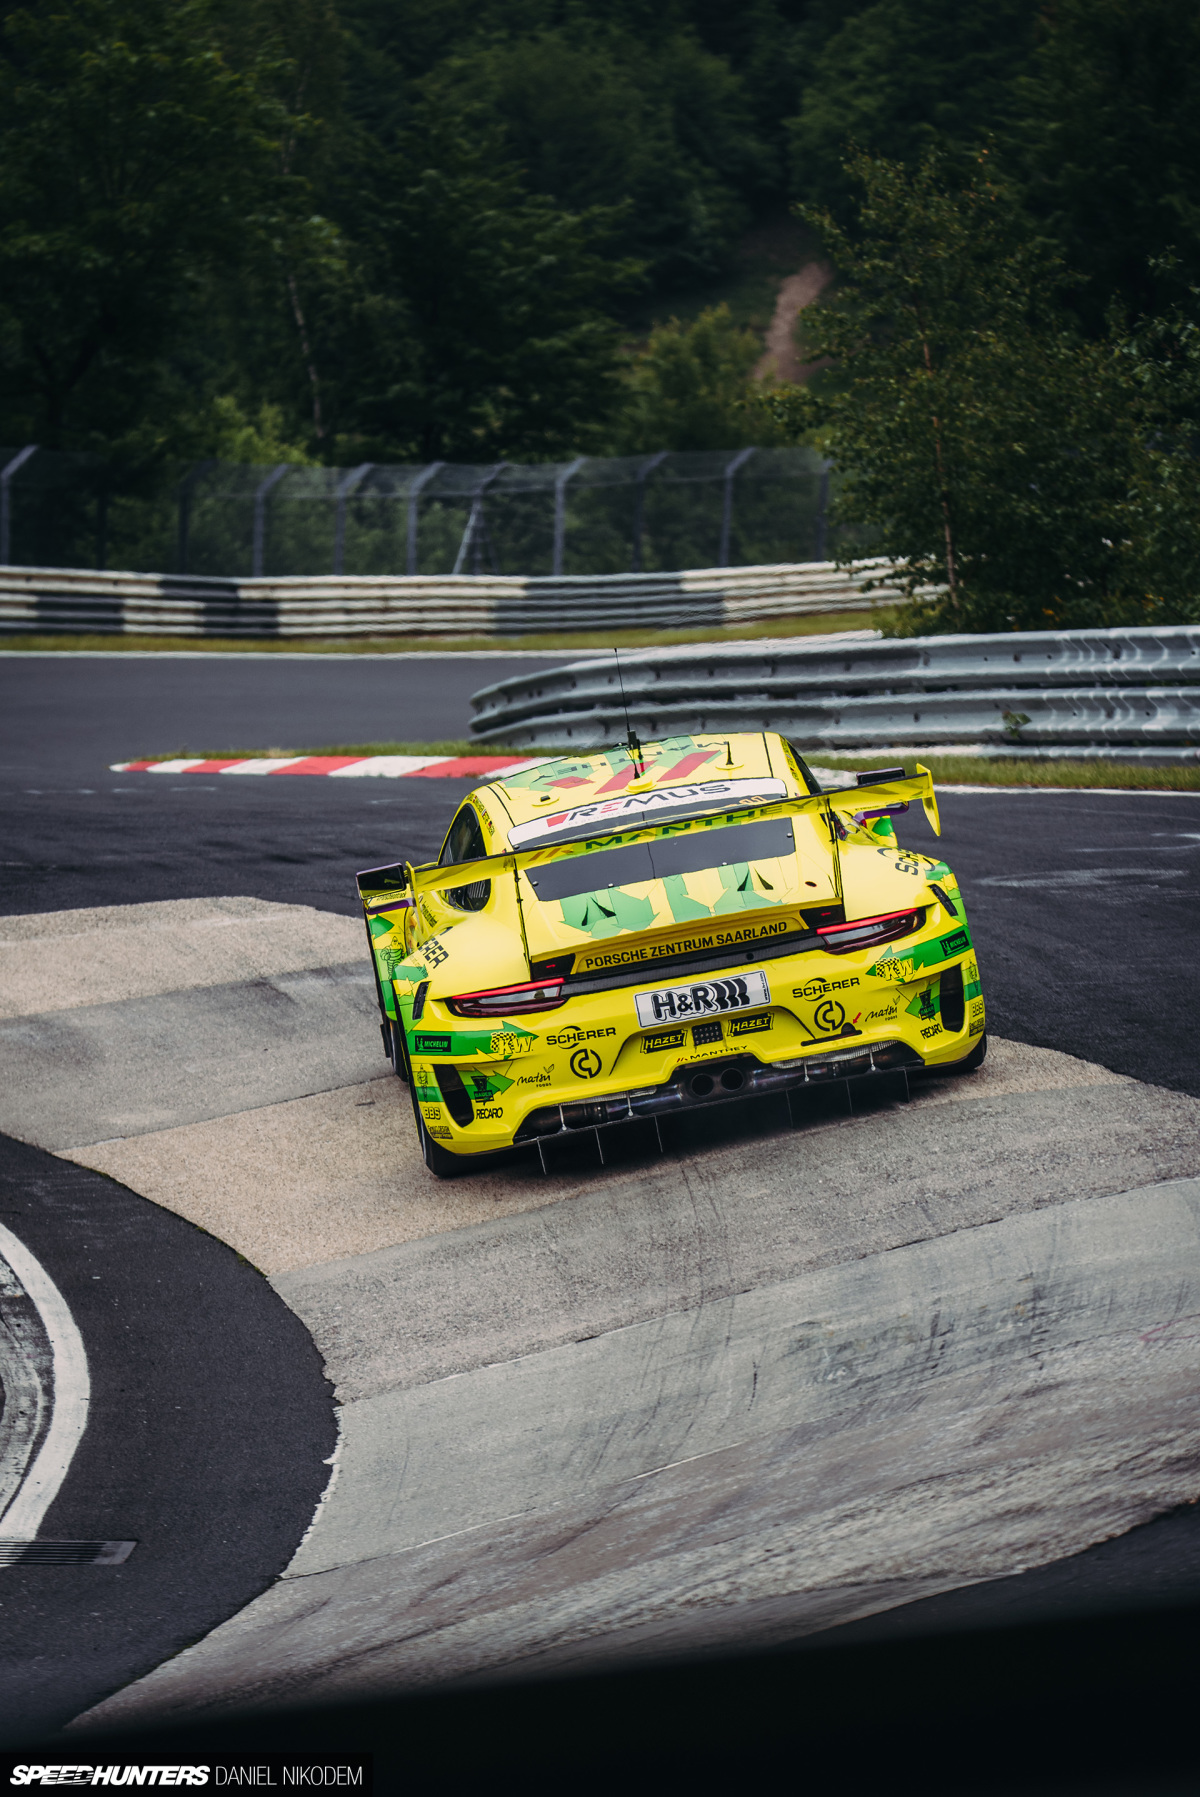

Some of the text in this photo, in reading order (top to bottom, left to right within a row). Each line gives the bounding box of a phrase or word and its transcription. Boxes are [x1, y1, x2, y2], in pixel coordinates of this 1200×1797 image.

[568, 784, 731, 821] REMUS
[585, 799, 817, 849] MANTHEY
[586, 921, 788, 968] PORSCHE ZENTRUM SAARLAND
[792, 977, 860, 998] SCHERER
[651, 985, 718, 1021] H&R
[972, 1000, 984, 1017] BBS
[732, 1017, 769, 1032] HAZET
[920, 1023, 943, 1039] RECARO
[424, 1040, 448, 1048] MICHELIN
[546, 1027, 617, 1045] SCHERER
[645, 1034, 682, 1049] HAZET
[690, 1045, 748, 1060] MANTHEY
[423, 1107, 441, 1120] BBS
[476, 1107, 503, 1119] RECARO
